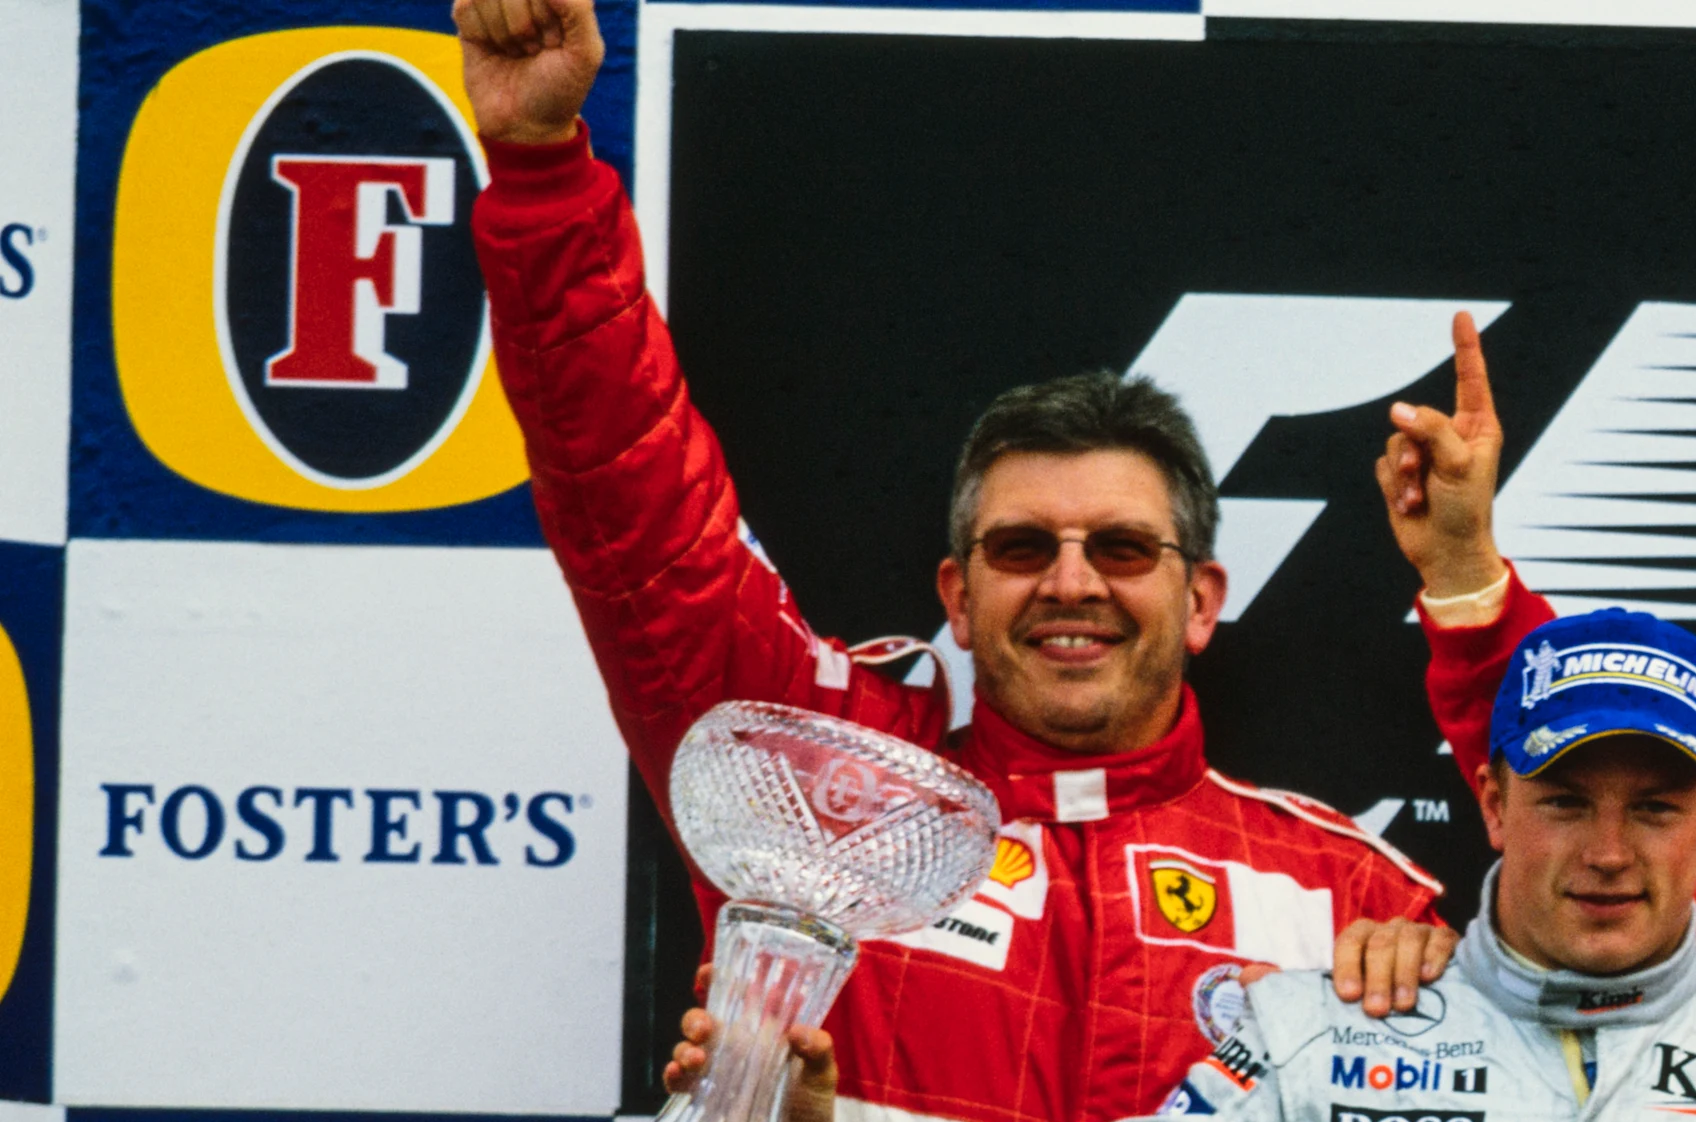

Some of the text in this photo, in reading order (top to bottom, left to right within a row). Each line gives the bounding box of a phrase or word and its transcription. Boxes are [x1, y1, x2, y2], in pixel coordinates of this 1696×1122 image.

[1412, 799, 1450, 822] TM
[98, 783, 577, 869] FOSTER'S
[1576, 987, 1643, 1010] Kimi
[1331, 1054, 1443, 1092] Mobil
